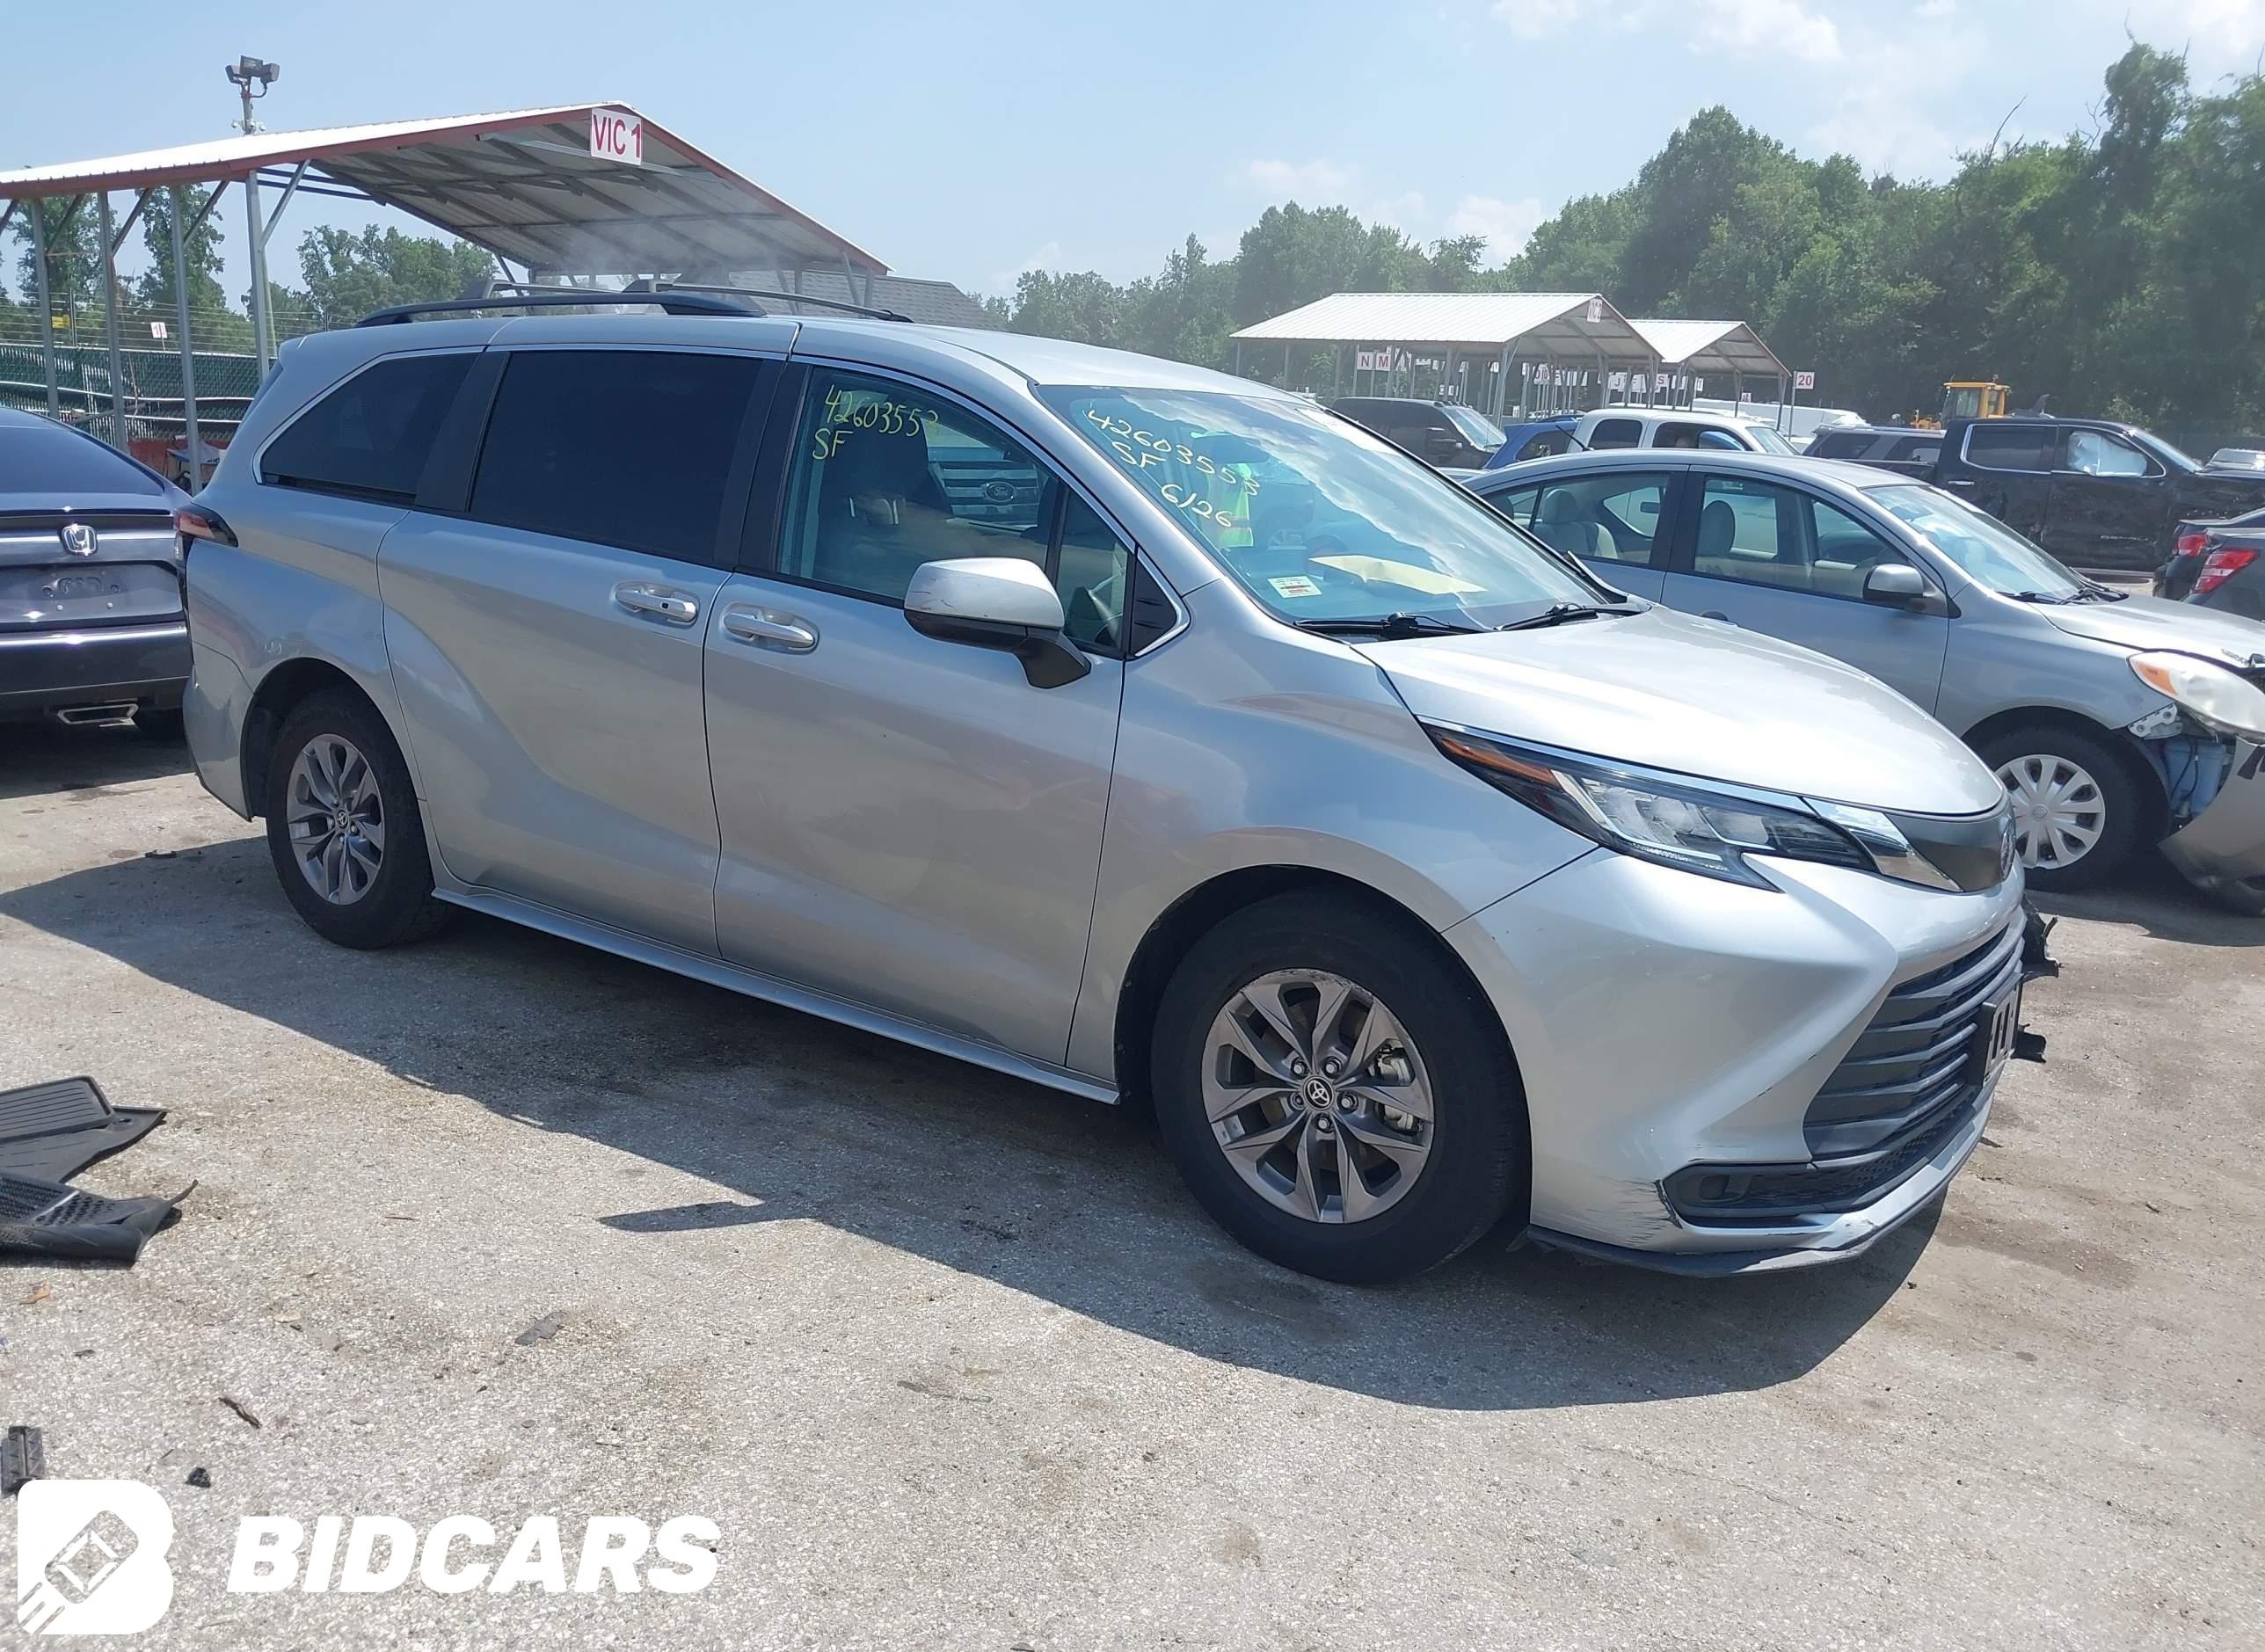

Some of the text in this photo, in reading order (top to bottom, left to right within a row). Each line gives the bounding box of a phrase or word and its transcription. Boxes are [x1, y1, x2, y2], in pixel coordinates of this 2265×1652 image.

[594, 114, 641, 158] VIC 1
[1360, 355, 1370, 367] N
[1378, 356, 1389, 368] M
[1657, 375, 1665, 384] S
[1798, 375, 1812, 386] 20
[812, 427, 854, 460] SF
[1088, 407, 1260, 497] 42603553
[1111, 440, 1167, 469] SF
